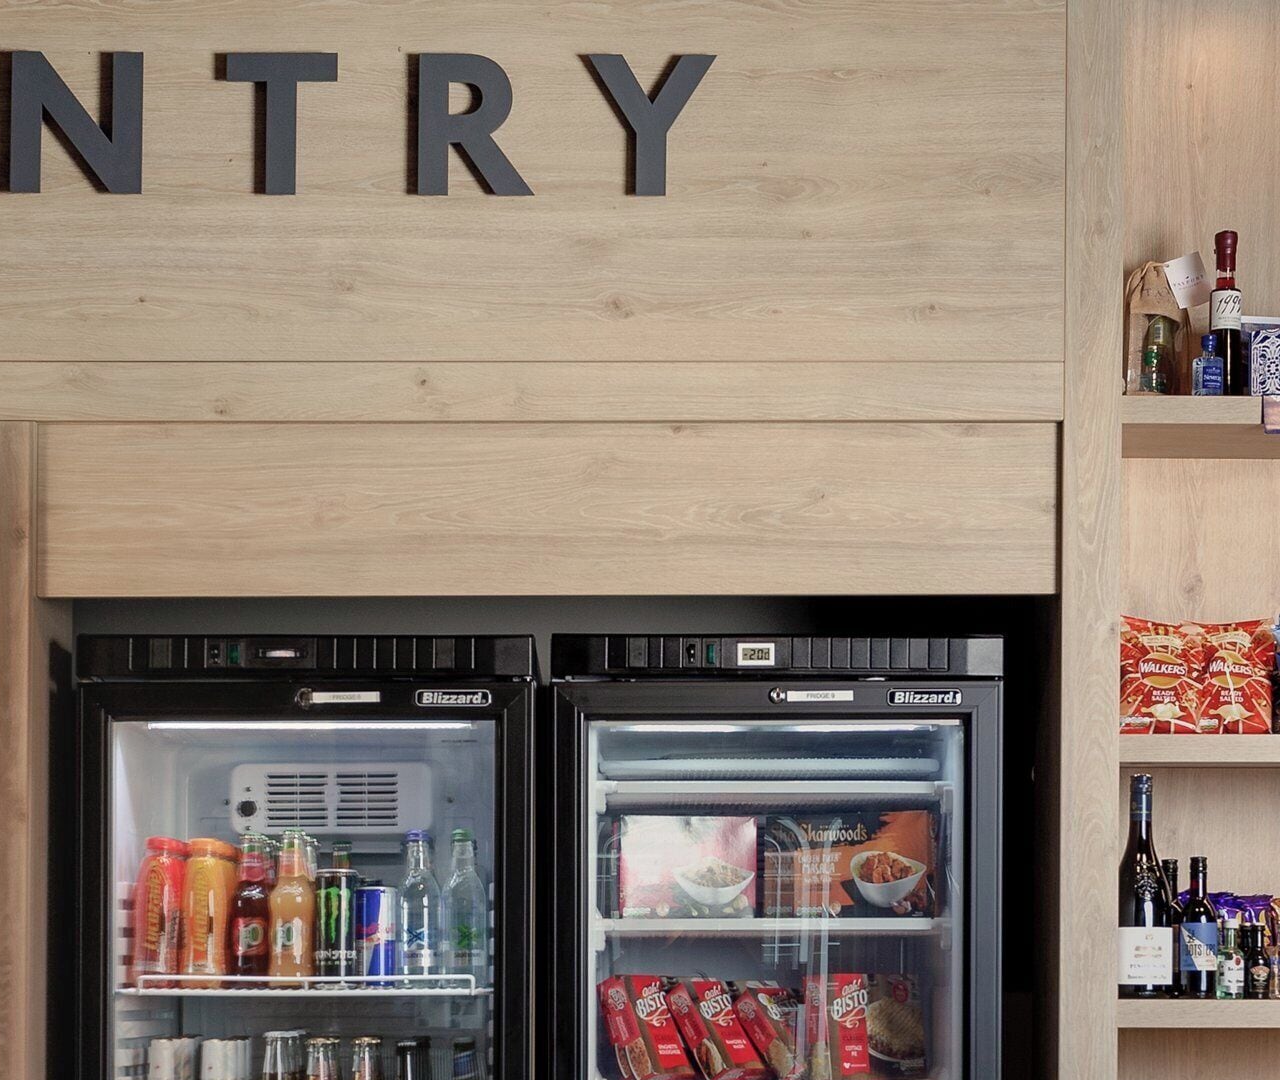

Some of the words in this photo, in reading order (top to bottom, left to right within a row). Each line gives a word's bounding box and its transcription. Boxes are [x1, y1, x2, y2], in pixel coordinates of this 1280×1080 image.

[1139, 660, 1186, 675] WALKERS
[1209, 660, 1253, 675] WALKERS
[635, 994, 667, 1019] BISTO
[700, 994, 733, 1019] BISTO
[832, 991, 868, 1018] BISTO
